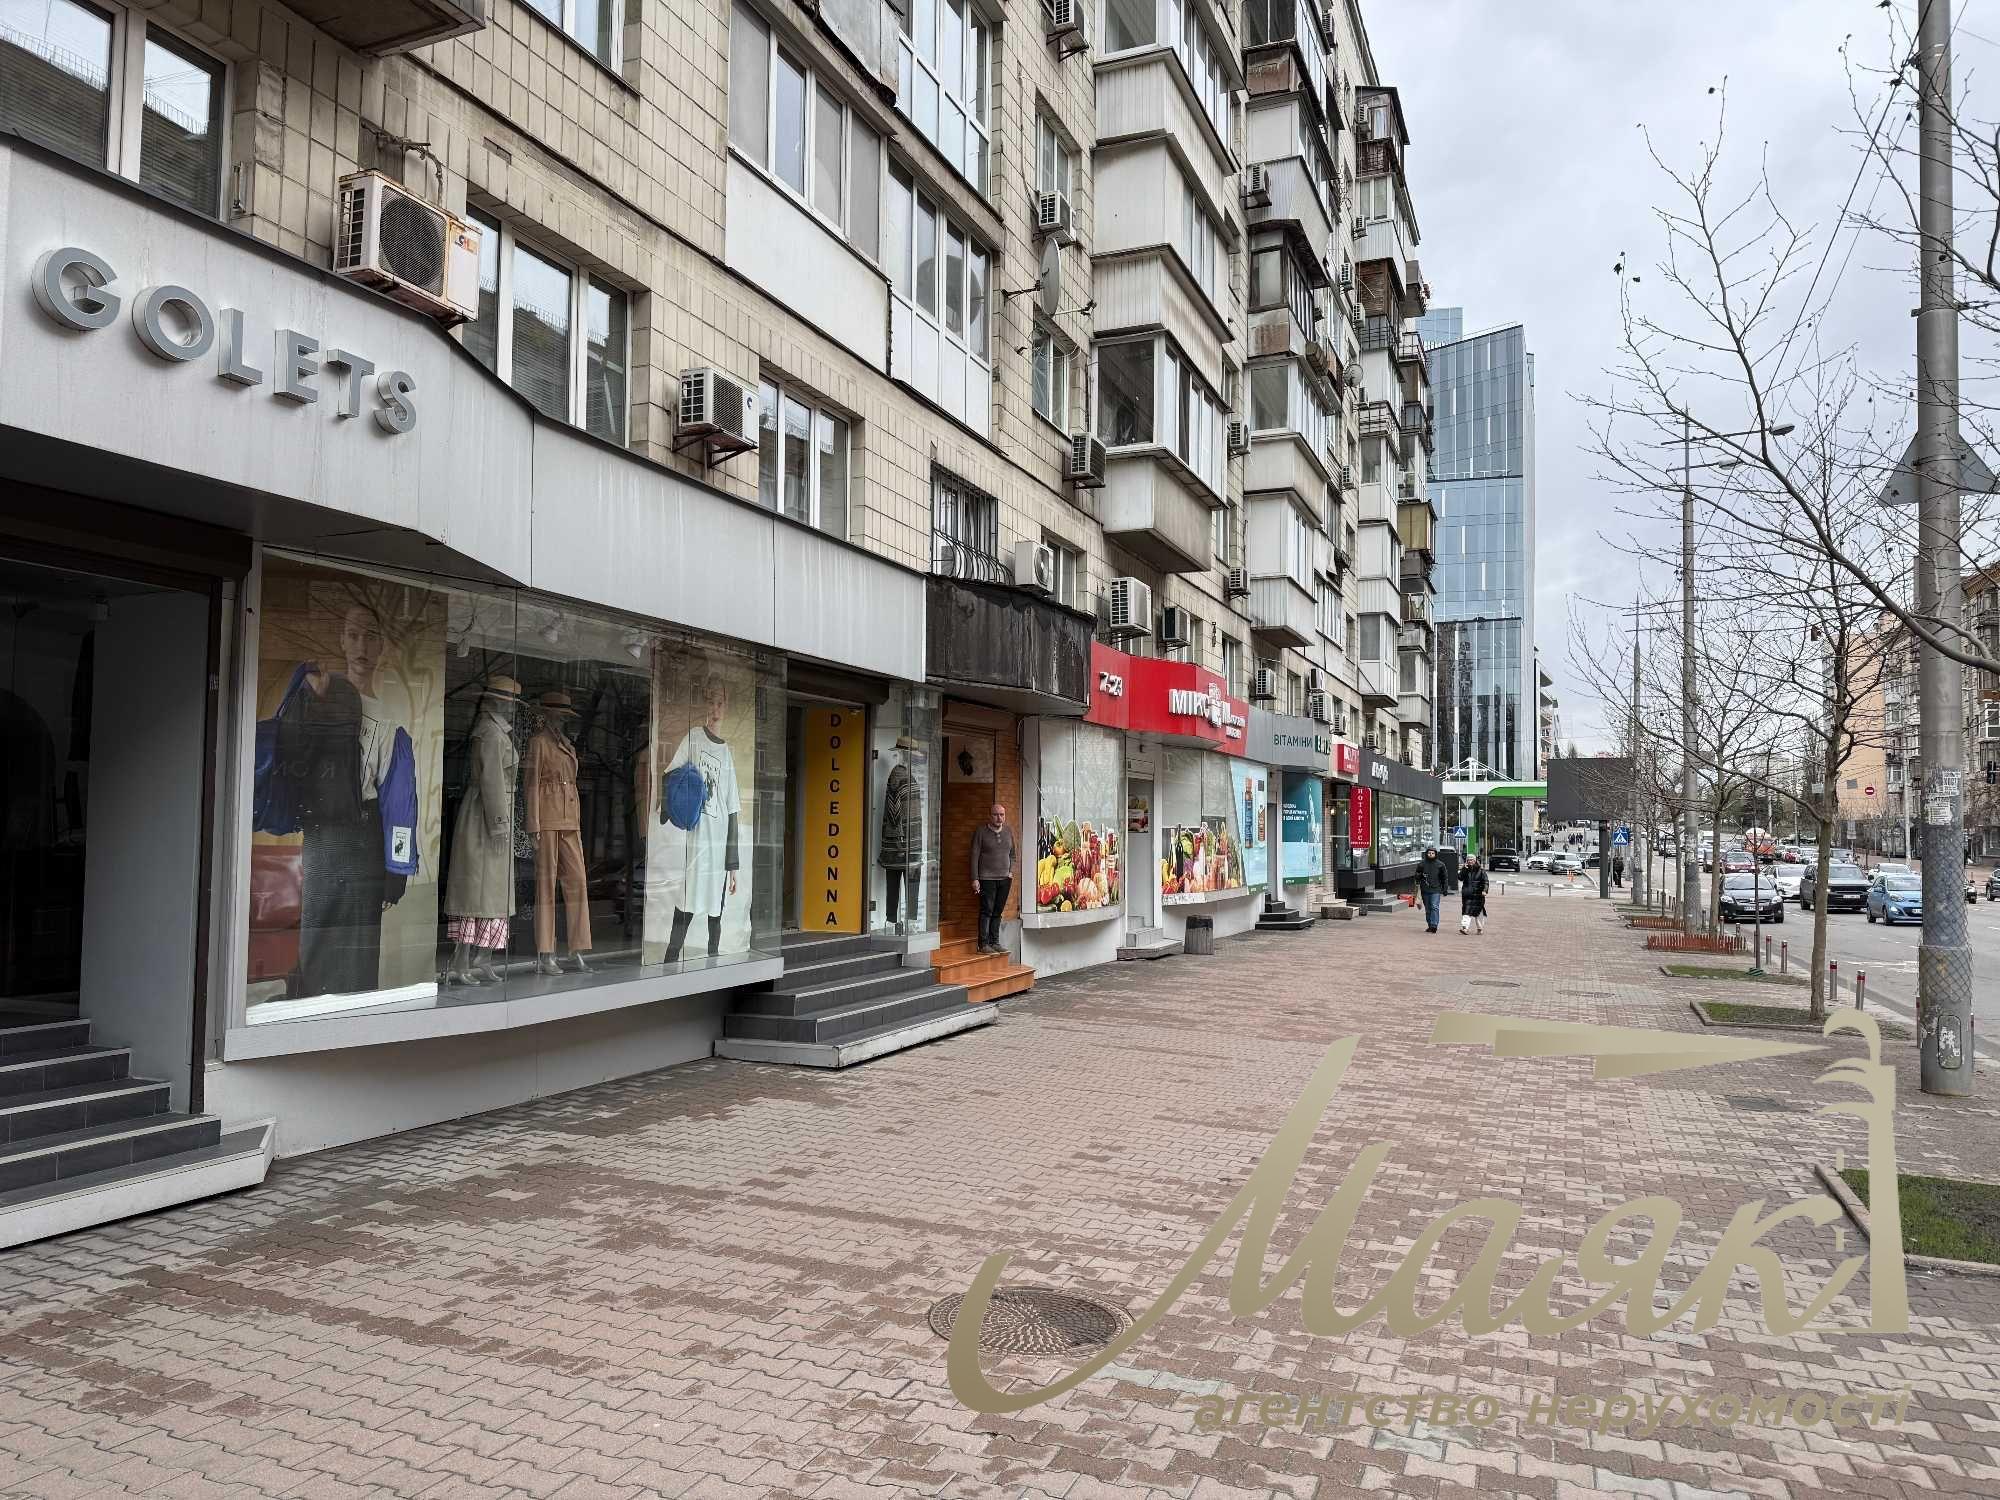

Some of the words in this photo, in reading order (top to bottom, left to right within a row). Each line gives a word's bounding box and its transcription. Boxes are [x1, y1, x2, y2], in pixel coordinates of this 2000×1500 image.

[31, 246, 417, 435] GOLETS
[826, 714, 842, 926] DOLCEDONNA
[1273, 734, 1313, 749] ВІТАМІНИ
